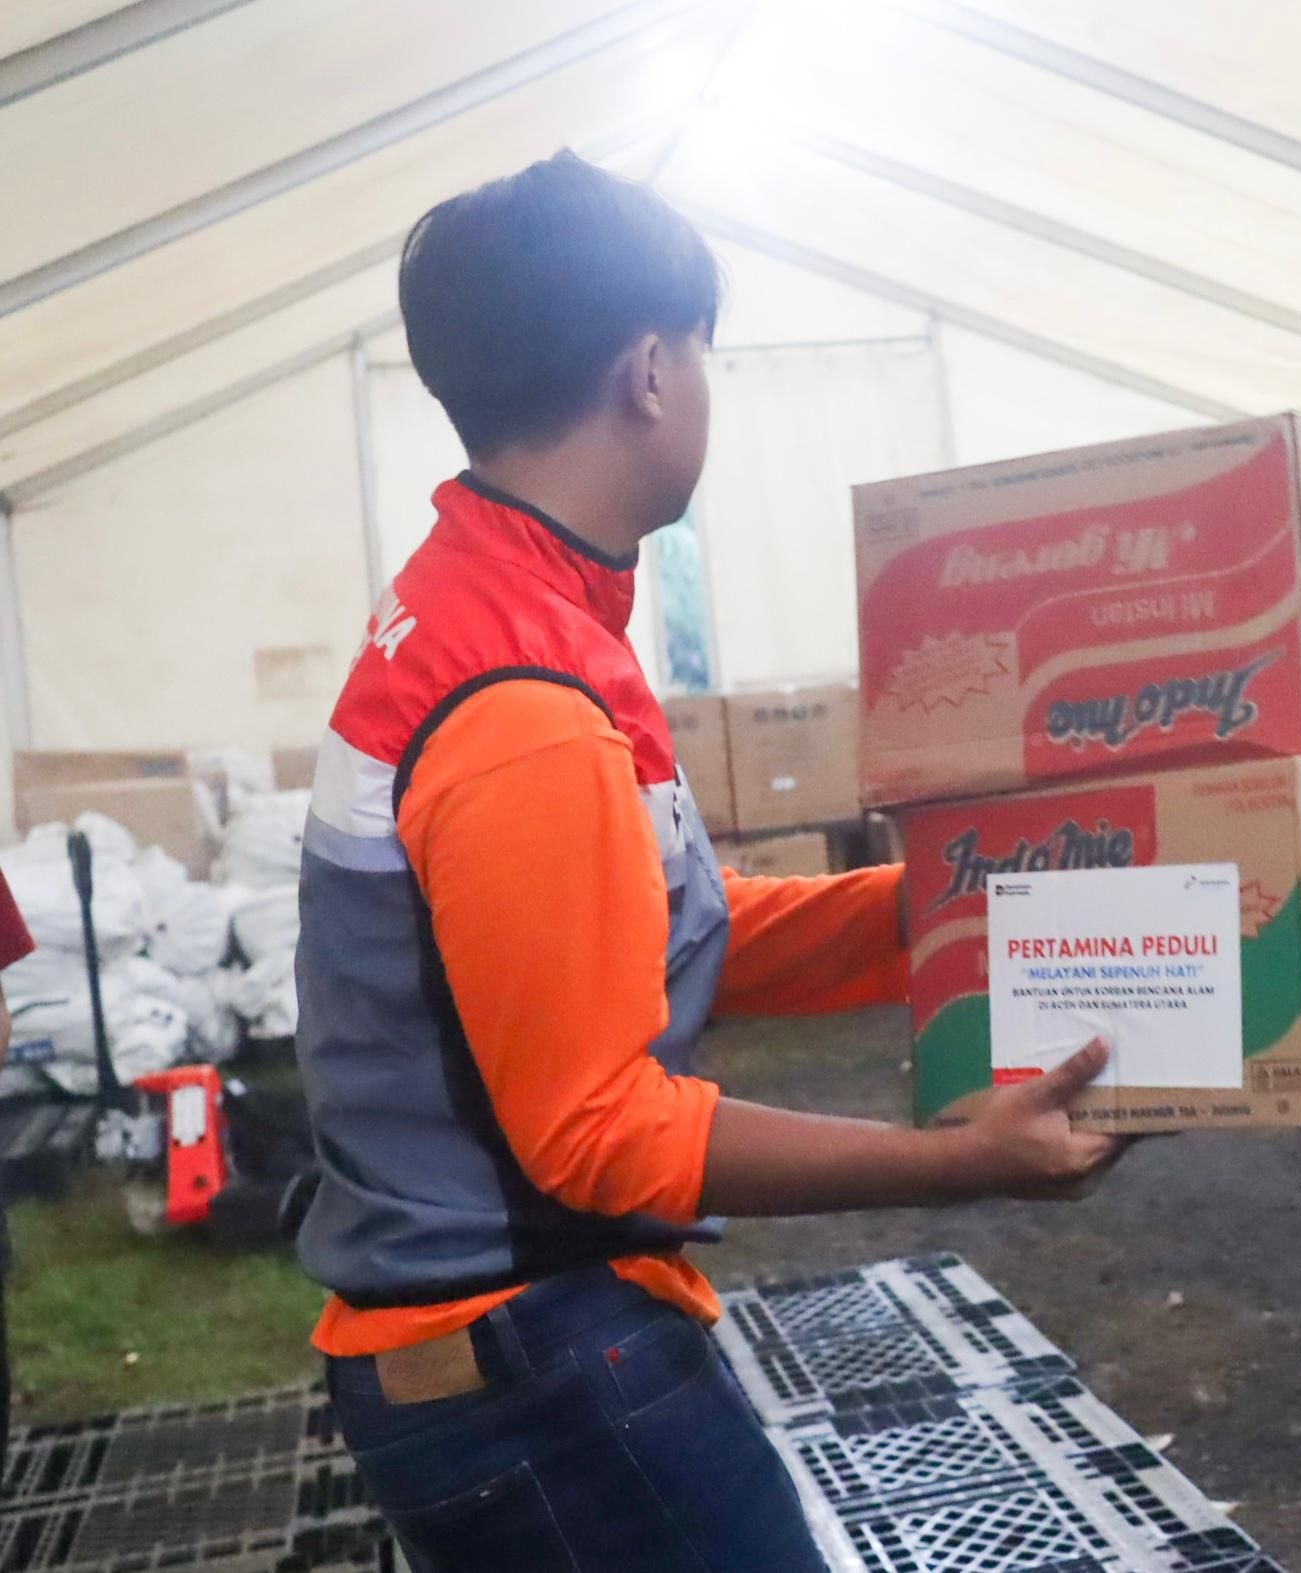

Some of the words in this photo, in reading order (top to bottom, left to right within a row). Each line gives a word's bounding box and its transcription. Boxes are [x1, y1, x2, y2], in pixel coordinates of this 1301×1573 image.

[1008, 937, 1133, 959] PERTAMINA
[1142, 935, 1218, 957] PEDULI
[1100, 965, 1160, 979] SEPENUH
[1012, 987, 1058, 998] BANTUAN
[1060, 987, 1093, 997] UNTUK
[1187, 986, 1215, 996] ALAM
